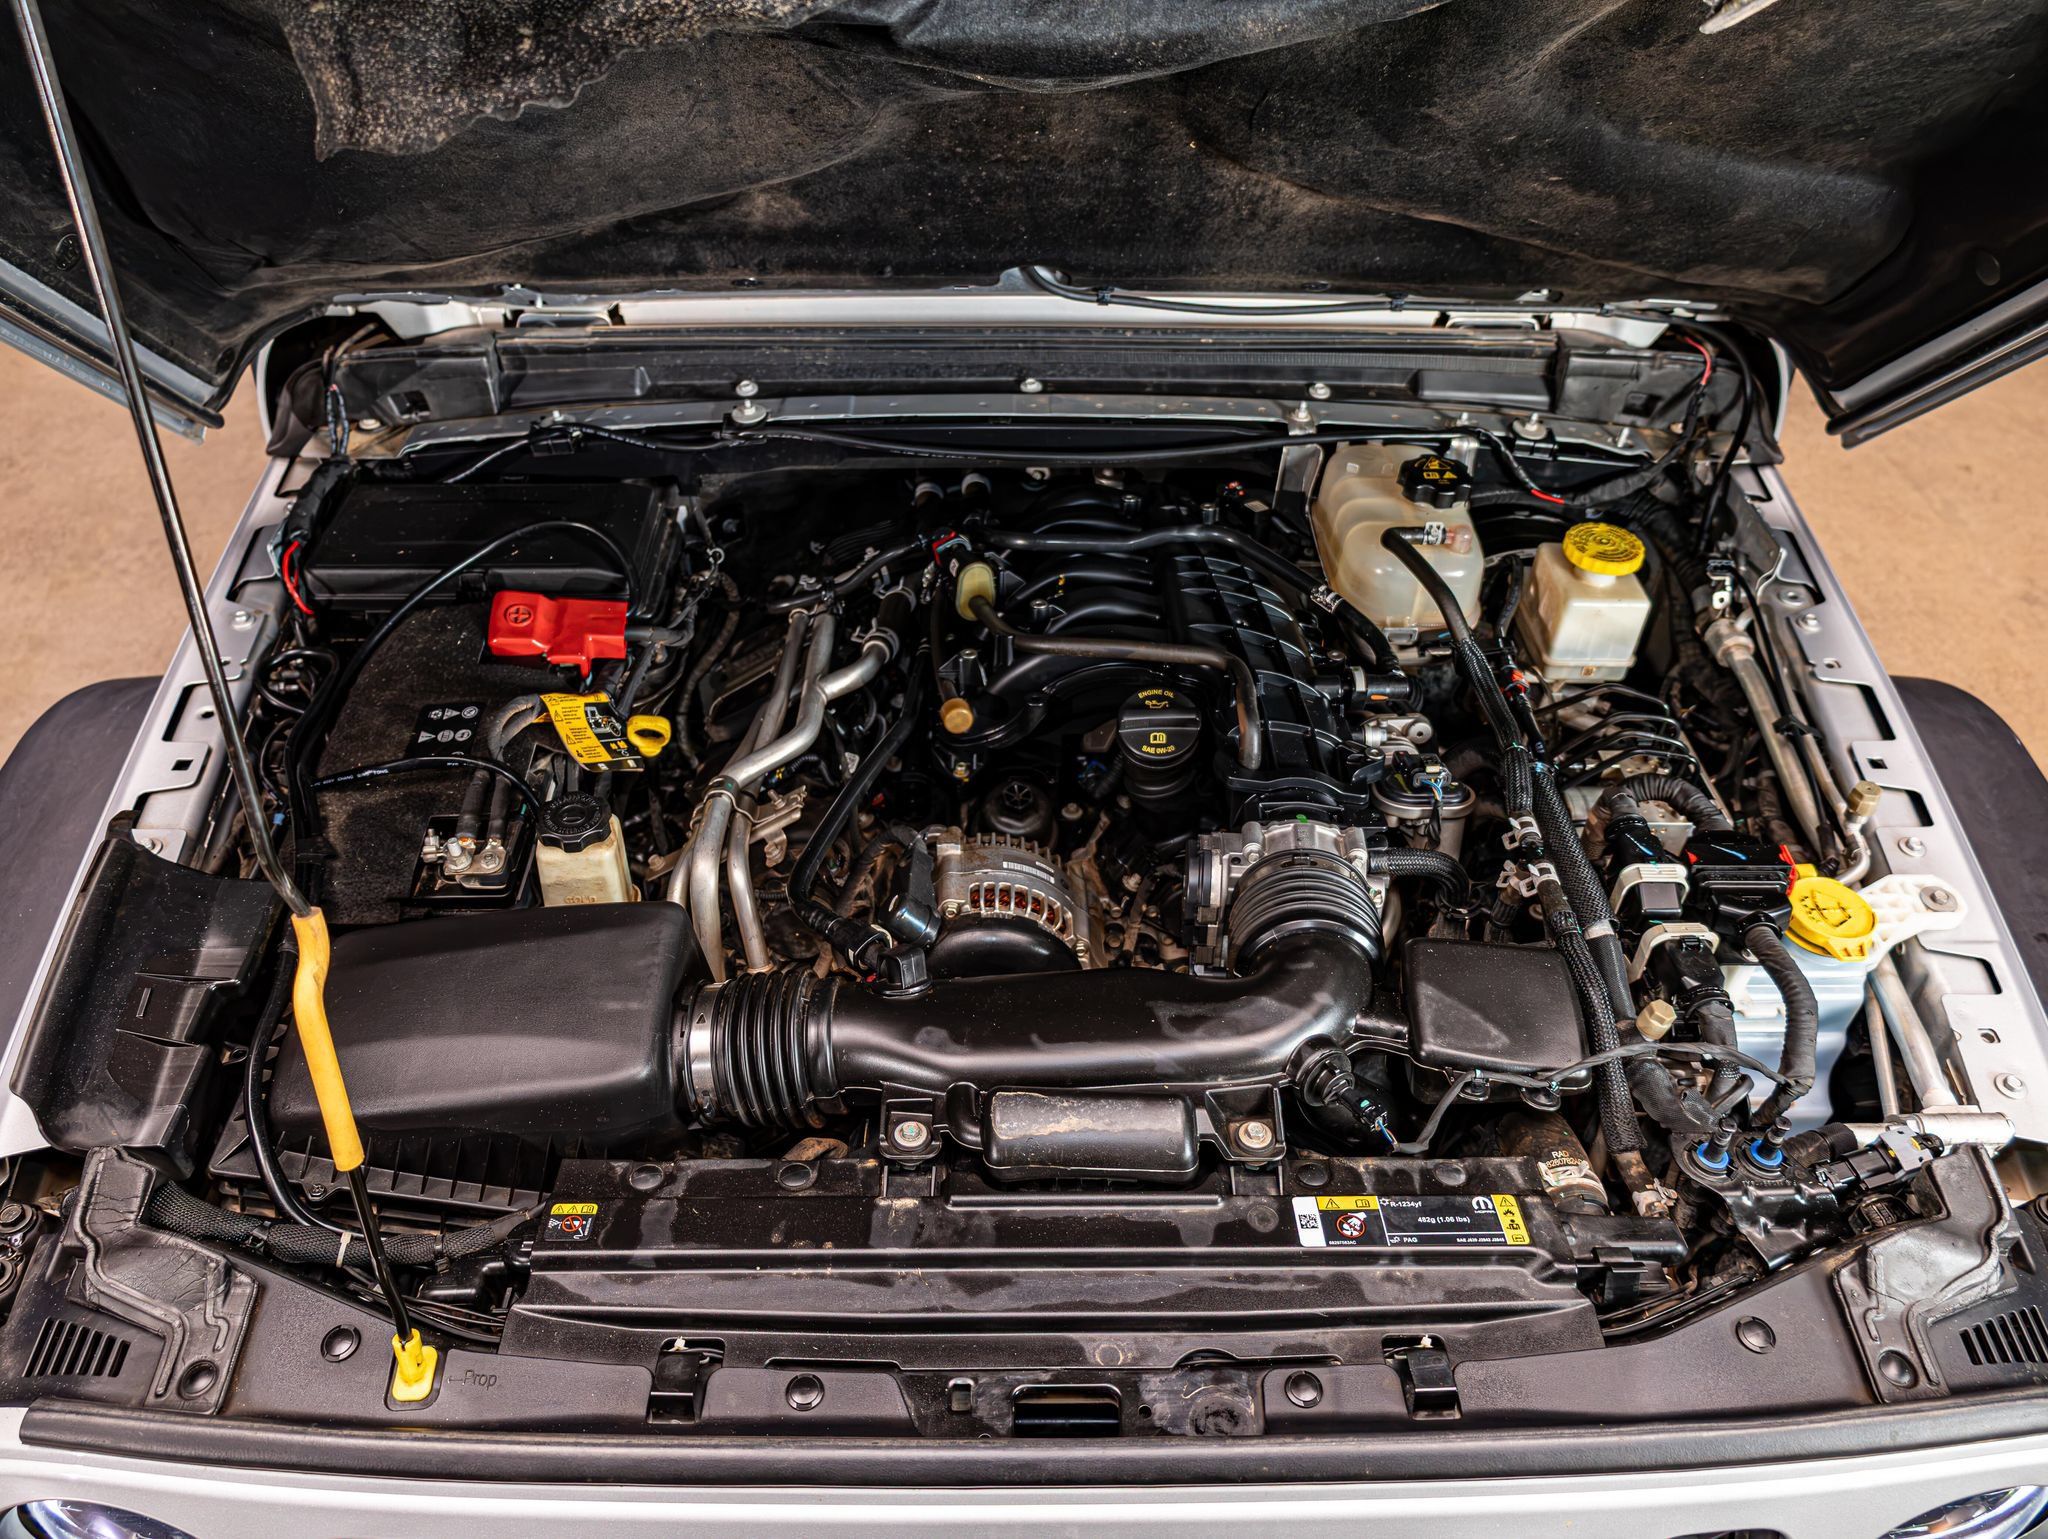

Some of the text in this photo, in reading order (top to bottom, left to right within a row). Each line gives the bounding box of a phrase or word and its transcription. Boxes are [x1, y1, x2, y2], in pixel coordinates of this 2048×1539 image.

[1138, 689, 1175, 699] ENGINE OIL
[1141, 745, 1175, 754] SAE 0W-20
[1551, 1150, 1570, 1159] RAD
[1390, 1200, 1422, 1208] R-1234yf
[1417, 1216, 1436, 1224] 482g
[1455, 1216, 1471, 1224] lbs)
[463, 1369, 498, 1391] Prop
